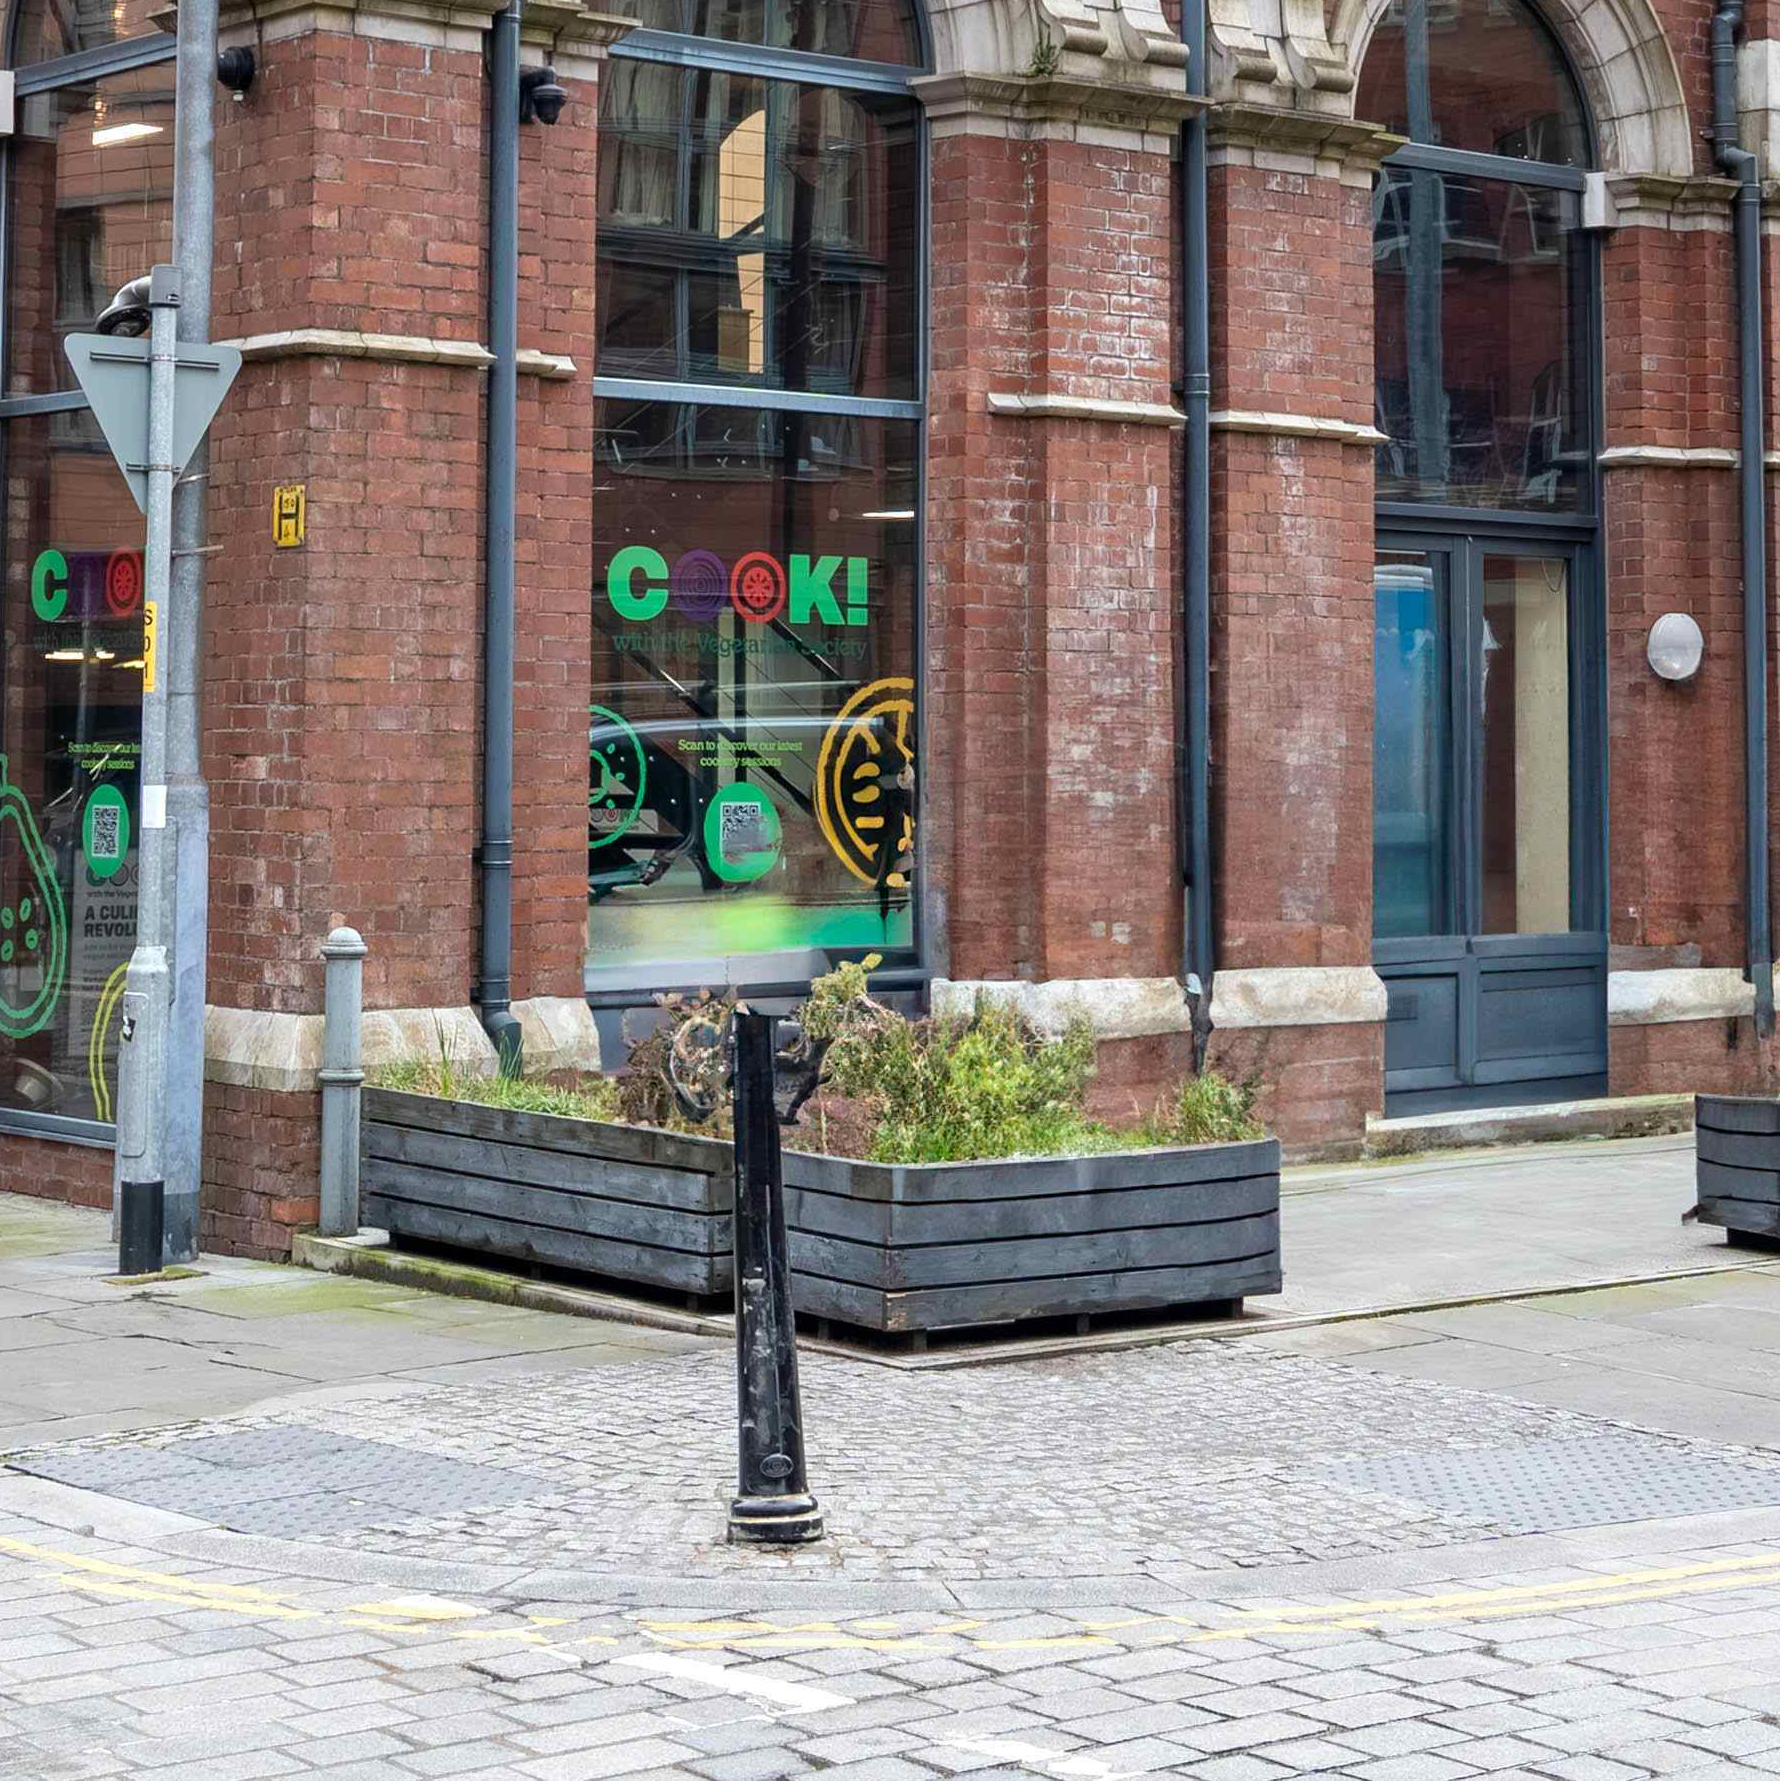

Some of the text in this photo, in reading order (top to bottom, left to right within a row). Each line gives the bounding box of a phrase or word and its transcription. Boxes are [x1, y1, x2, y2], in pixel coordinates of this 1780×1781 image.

[607, 545, 868, 626] COOK!
[678, 738, 704, 751] Scan
[706, 740, 715, 751] to
[85, 904, 138, 920] A CULI
